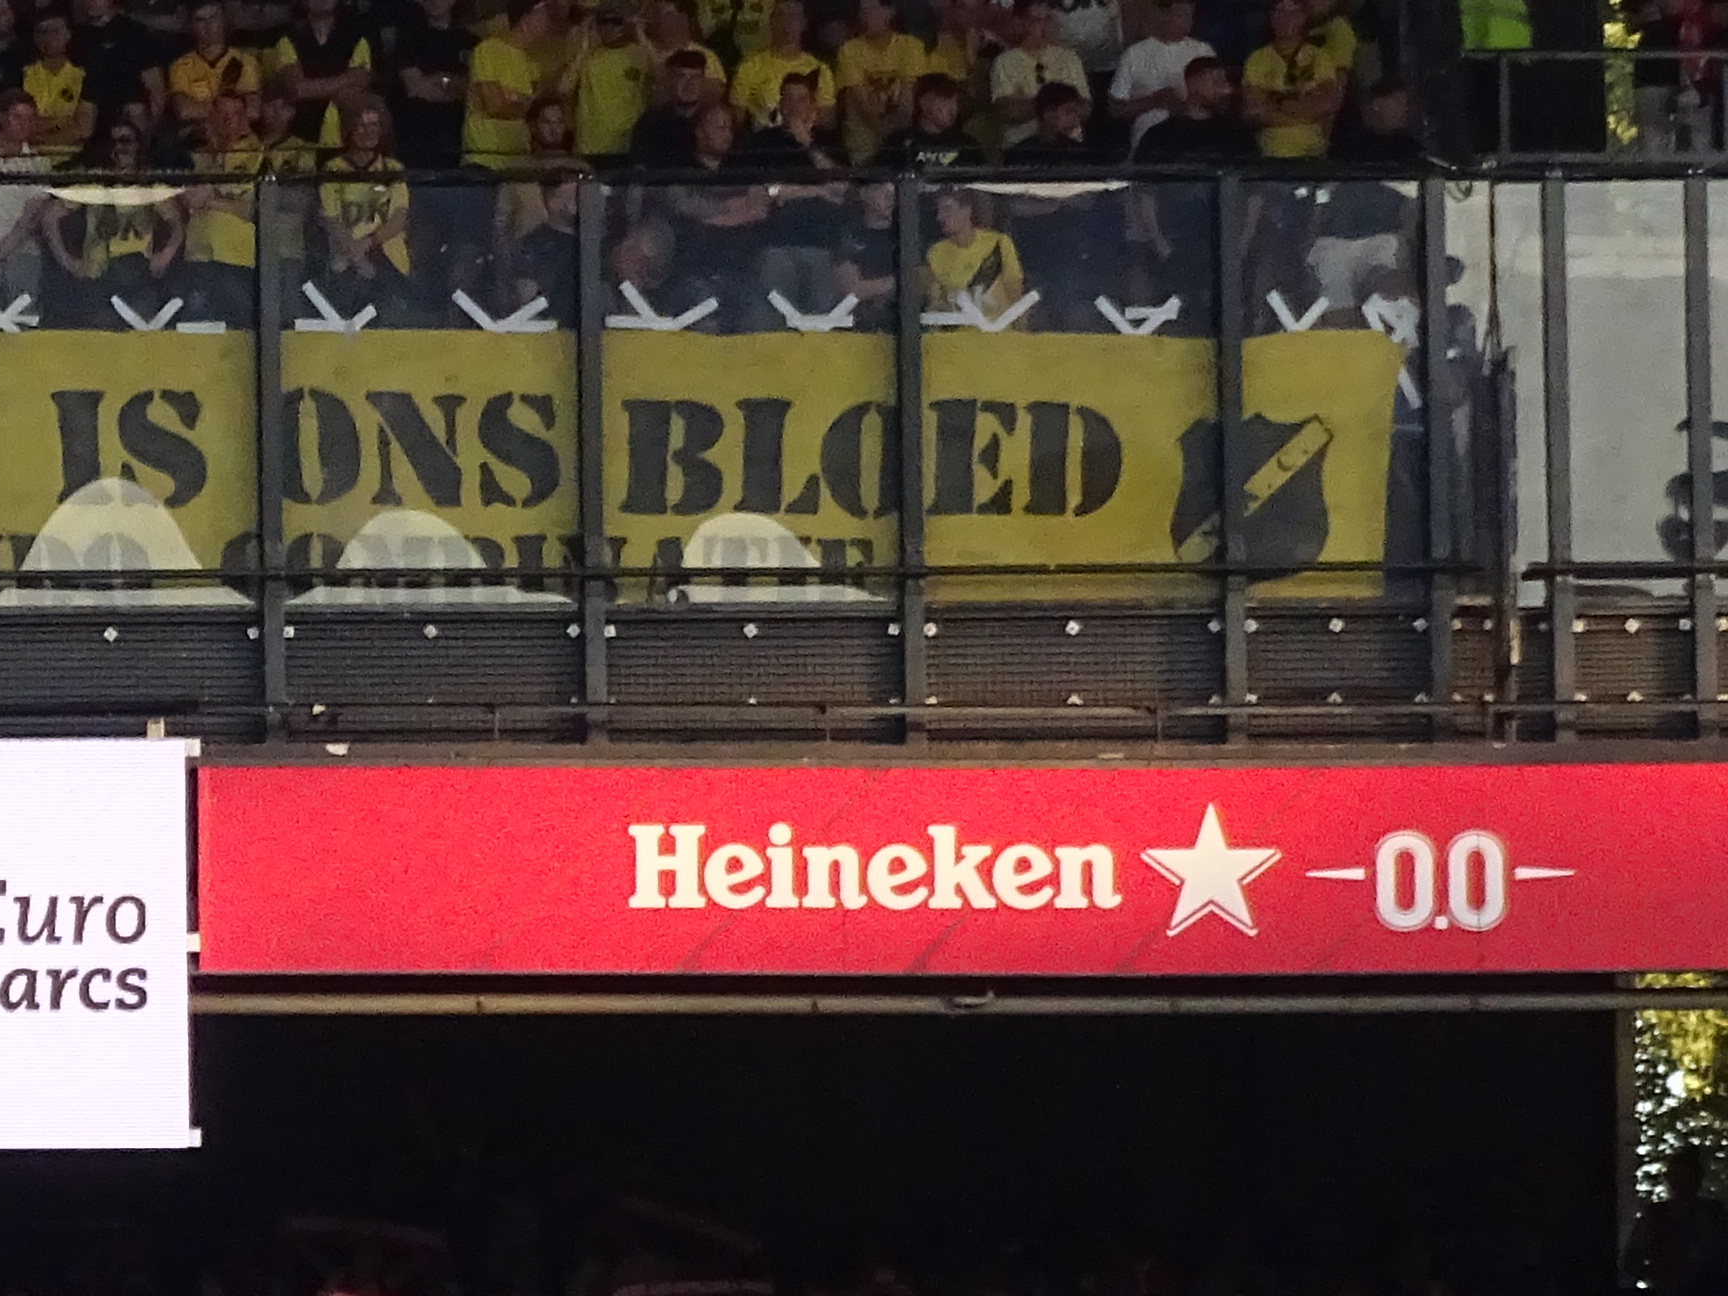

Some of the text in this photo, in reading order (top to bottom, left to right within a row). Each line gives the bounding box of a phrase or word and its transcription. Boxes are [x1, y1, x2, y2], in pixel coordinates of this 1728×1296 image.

[51, 389, 208, 508] IS
[281, 389, 561, 505] ONS
[620, 396, 1123, 520] BLOED
[628, 822, 1506, 931] Heineken 0.0
